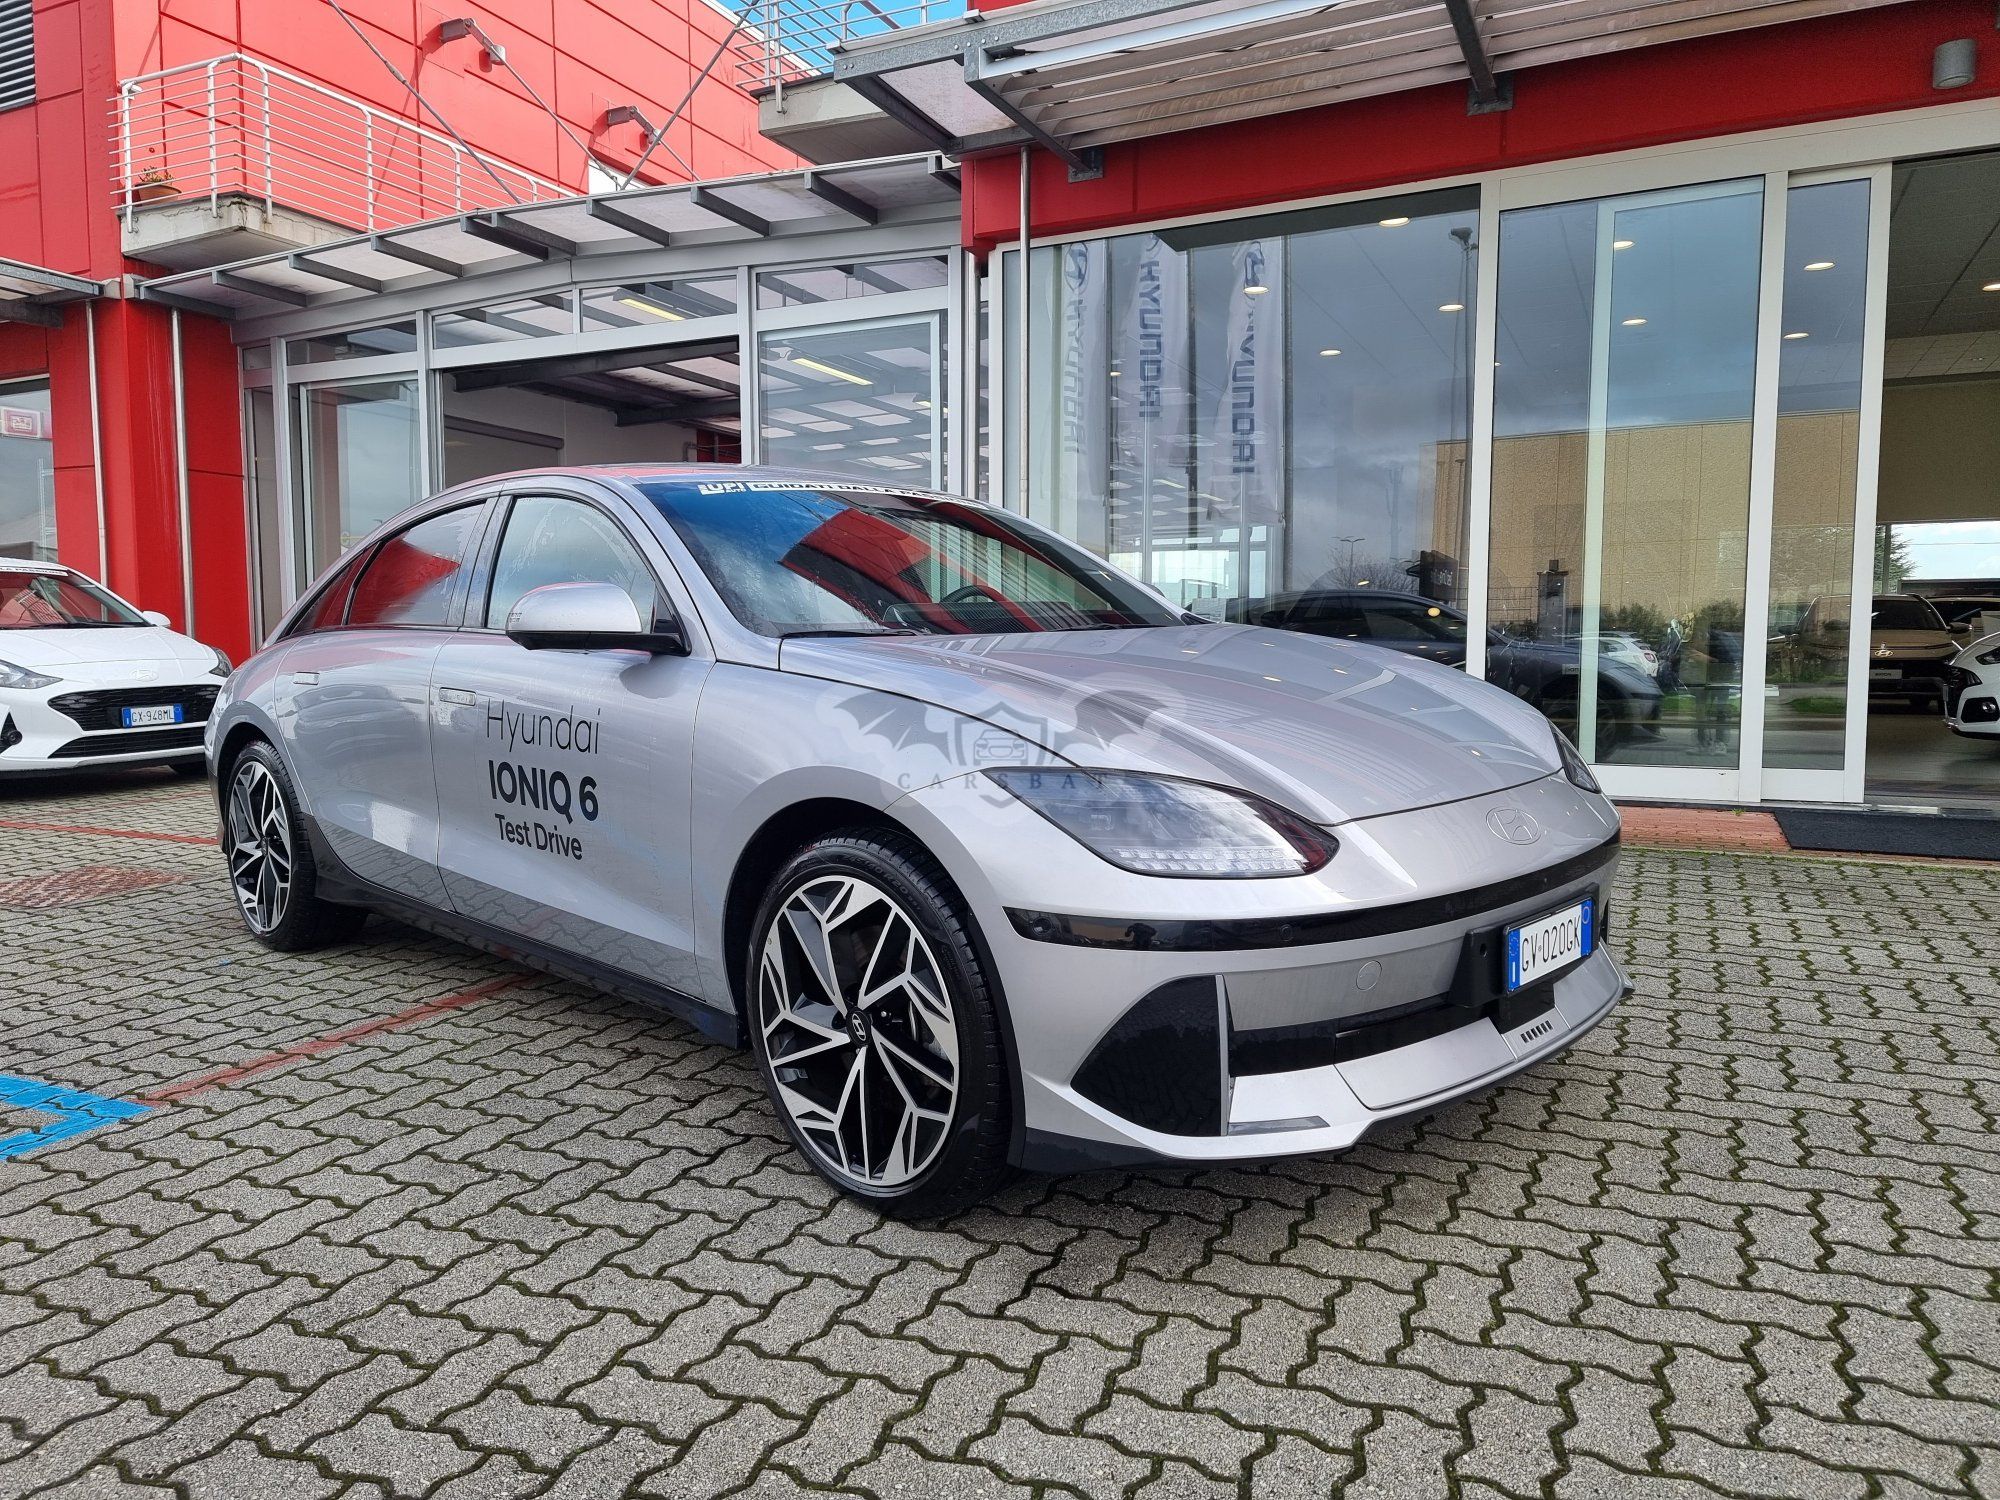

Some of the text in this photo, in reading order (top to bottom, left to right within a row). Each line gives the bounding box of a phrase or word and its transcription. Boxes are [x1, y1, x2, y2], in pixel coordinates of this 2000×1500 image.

[1138, 260, 1163, 418] HYUNDAI
[1064, 298, 1087, 455] HYUNDAI
[487, 698, 601, 754] Hyundai
[488, 759, 599, 824] IONIQ 6
[495, 813, 583, 860] Test Drive
